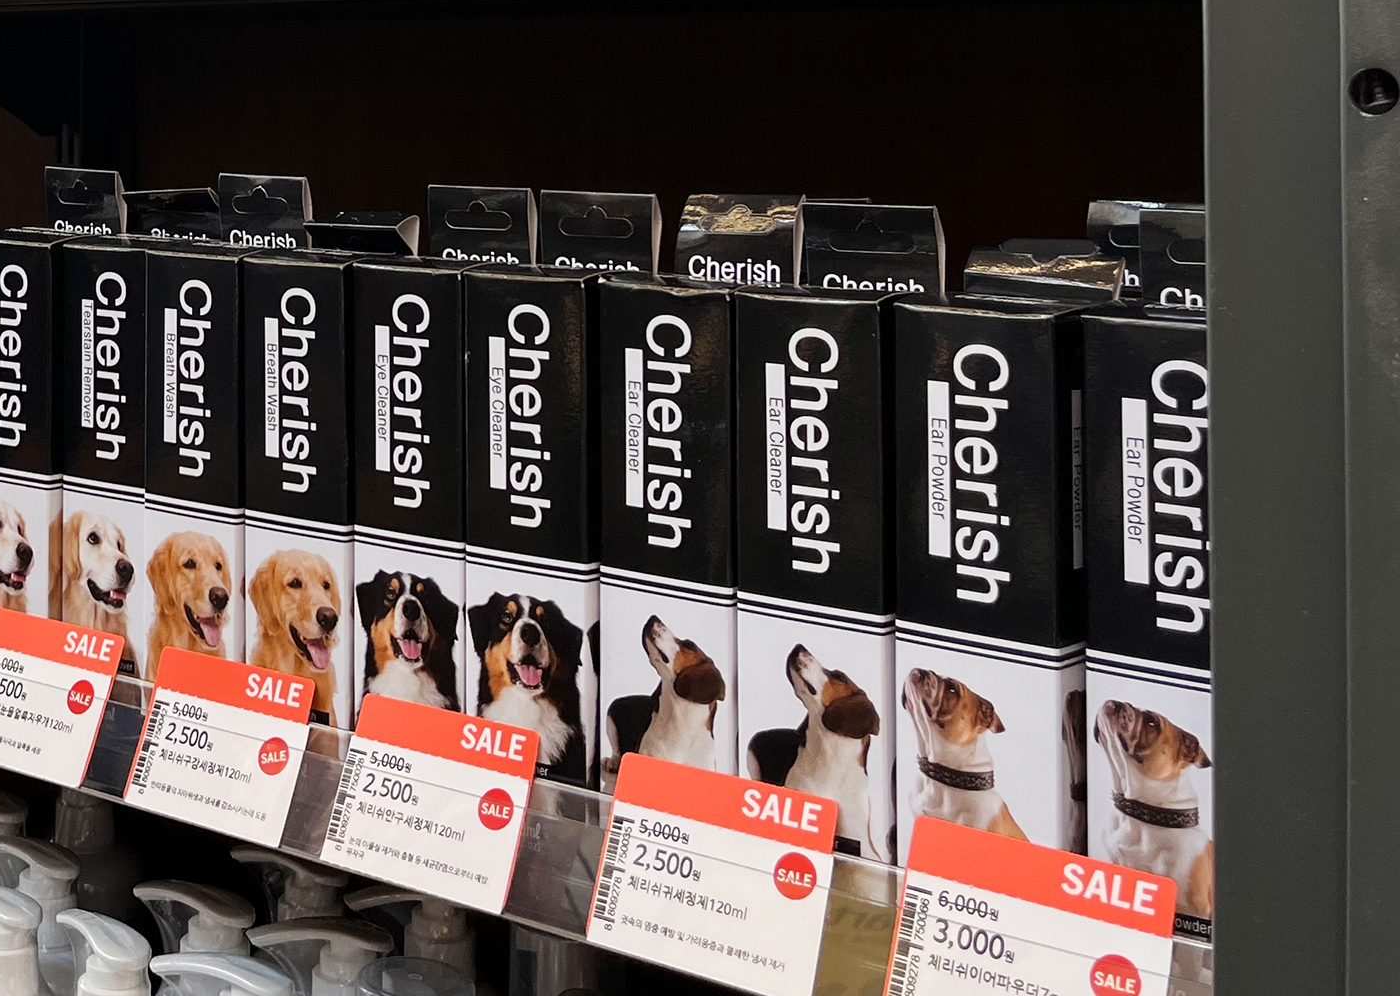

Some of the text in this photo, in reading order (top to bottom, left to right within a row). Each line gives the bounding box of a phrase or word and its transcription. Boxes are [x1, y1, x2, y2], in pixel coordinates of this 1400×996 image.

[228, 228, 298, 250] Cherish
[687, 254, 781, 288] Cherish
[165, 332, 177, 419] Breath Wash
[179, 279, 213, 478] Cherish
[281, 287, 318, 494] Cherish
[376, 354, 389, 442] Eye Cleaner
[392, 293, 431, 510] Cherish
[628, 380, 642, 476] Ear Cleaner
[645, 314, 693, 550] Cherish
[788, 327, 841, 575] Cherish
[953, 344, 1011, 606] Cherish
[1126, 435, 1146, 545] Ear Powder
[1150, 359, 1212, 635] Cherish
[63, 630, 116, 663] SALE
[244, 672, 306, 709] SALE
[459, 722, 528, 762] SALE
[740, 787, 823, 834] SALE
[632, 842, 702, 883] 2,500원
[775, 867, 813, 889] SALE
[1060, 861, 1159, 918] SALE
[627, 874, 748, 922] 체리쉬귀세정제120ml
[931, 918, 1017, 965] 3,000원
[1093, 970, 1138, 995] SALE
